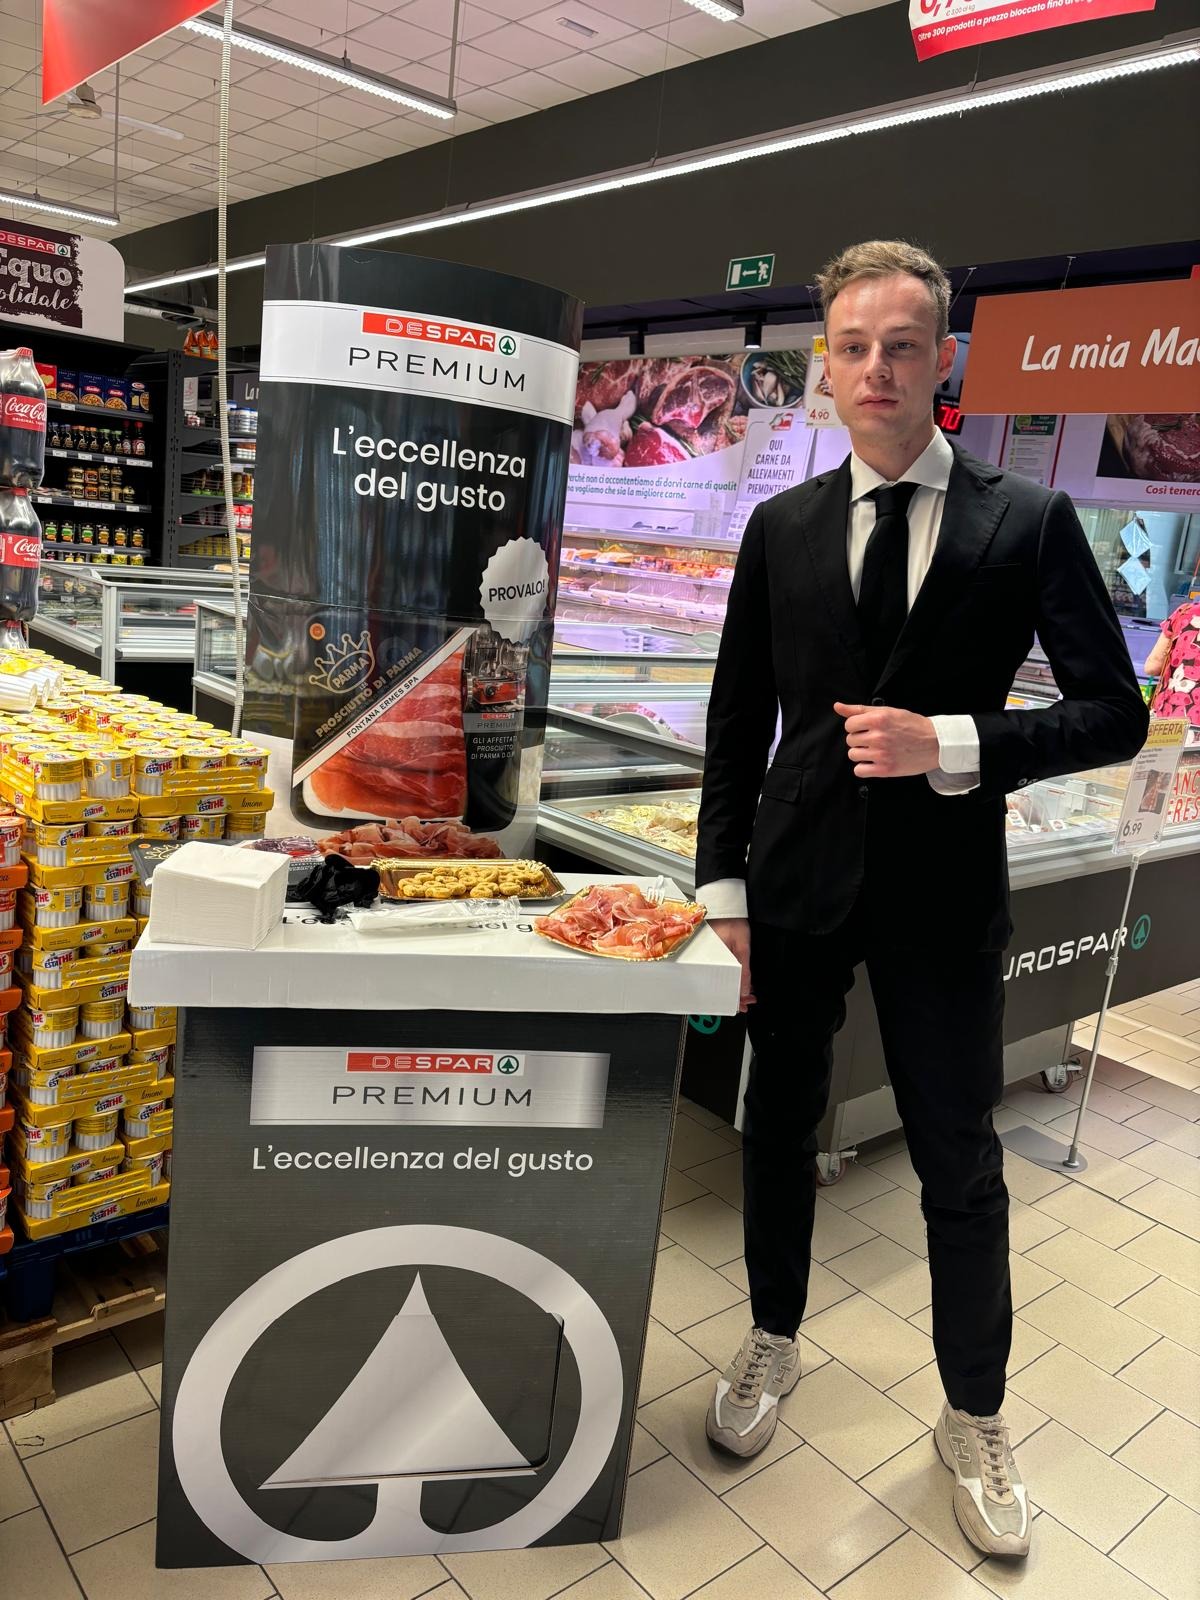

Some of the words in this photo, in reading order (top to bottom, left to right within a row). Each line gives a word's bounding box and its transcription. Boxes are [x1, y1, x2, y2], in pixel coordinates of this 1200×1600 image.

[917, 32, 931, 41] Oltre
[932, 26, 946, 37] 300
[946, 18, 976, 36] prodotti
[976, 18, 982, 26] a
[982, 12, 1008, 26] prezzo
[1010, 2, 1046, 18] bloccato
[0, 282, 73, 310] olidale
[385, 318, 494, 349] DESPAR
[1020, 335, 1062, 372] La
[1069, 334, 1131, 370] mia
[348, 346, 526, 392] PREMIUM
[810, 408, 830, 420] 4.90
[940, 405, 960, 431] 70
[332, 424, 526, 479] L'eccellenza
[769, 439, 783, 452] QUI
[755, 454, 780, 465] CARNE
[780, 454, 791, 466] DA
[605, 475, 654, 486] accontentiamo
[655, 476, 662, 487] di
[663, 477, 682, 488] darvi
[683, 480, 704, 489] carne
[704, 480, 712, 490] di
[713, 480, 737, 492] qualit
[747, 468, 795, 481] ALLEVAMENTI
[354, 468, 406, 500] del
[416, 479, 506, 512] gusto
[575, 484, 604, 495] vogliamo
[605, 485, 616, 495] che
[616, 486, 627, 496] sia
[627, 487, 634, 496] la
[635, 488, 664, 499] migliore
[664, 490, 687, 500] carne.
[747, 483, 789, 495] PIEMONTES
[488, 579, 546, 602] PROVALO!
[332, 656, 370, 688] PARMA
[315, 688, 373, 738] PROSCIUTTO
[372, 676, 387, 690] DI
[386, 647, 422, 678] PARMA
[346, 709, 380, 738] FONTANA
[380, 689, 404, 710] ERMES
[403, 676, 420, 690] SPA
[476, 744, 514, 752] PROSCIUTTO
[487, 736, 518, 744] AFFETTATI
[1168, 796, 1200, 824] RES
[1122, 820, 1142, 837] 6.99
[1002, 926, 1128, 982] UROSPAR
[372, 1055, 492, 1072] DESPAR
[332, 1086, 533, 1106] PREMIUM
[252, 1144, 444, 1170] L'eccellenza
[453, 1146, 500, 1170] del
[508, 1150, 594, 1178] gusto
